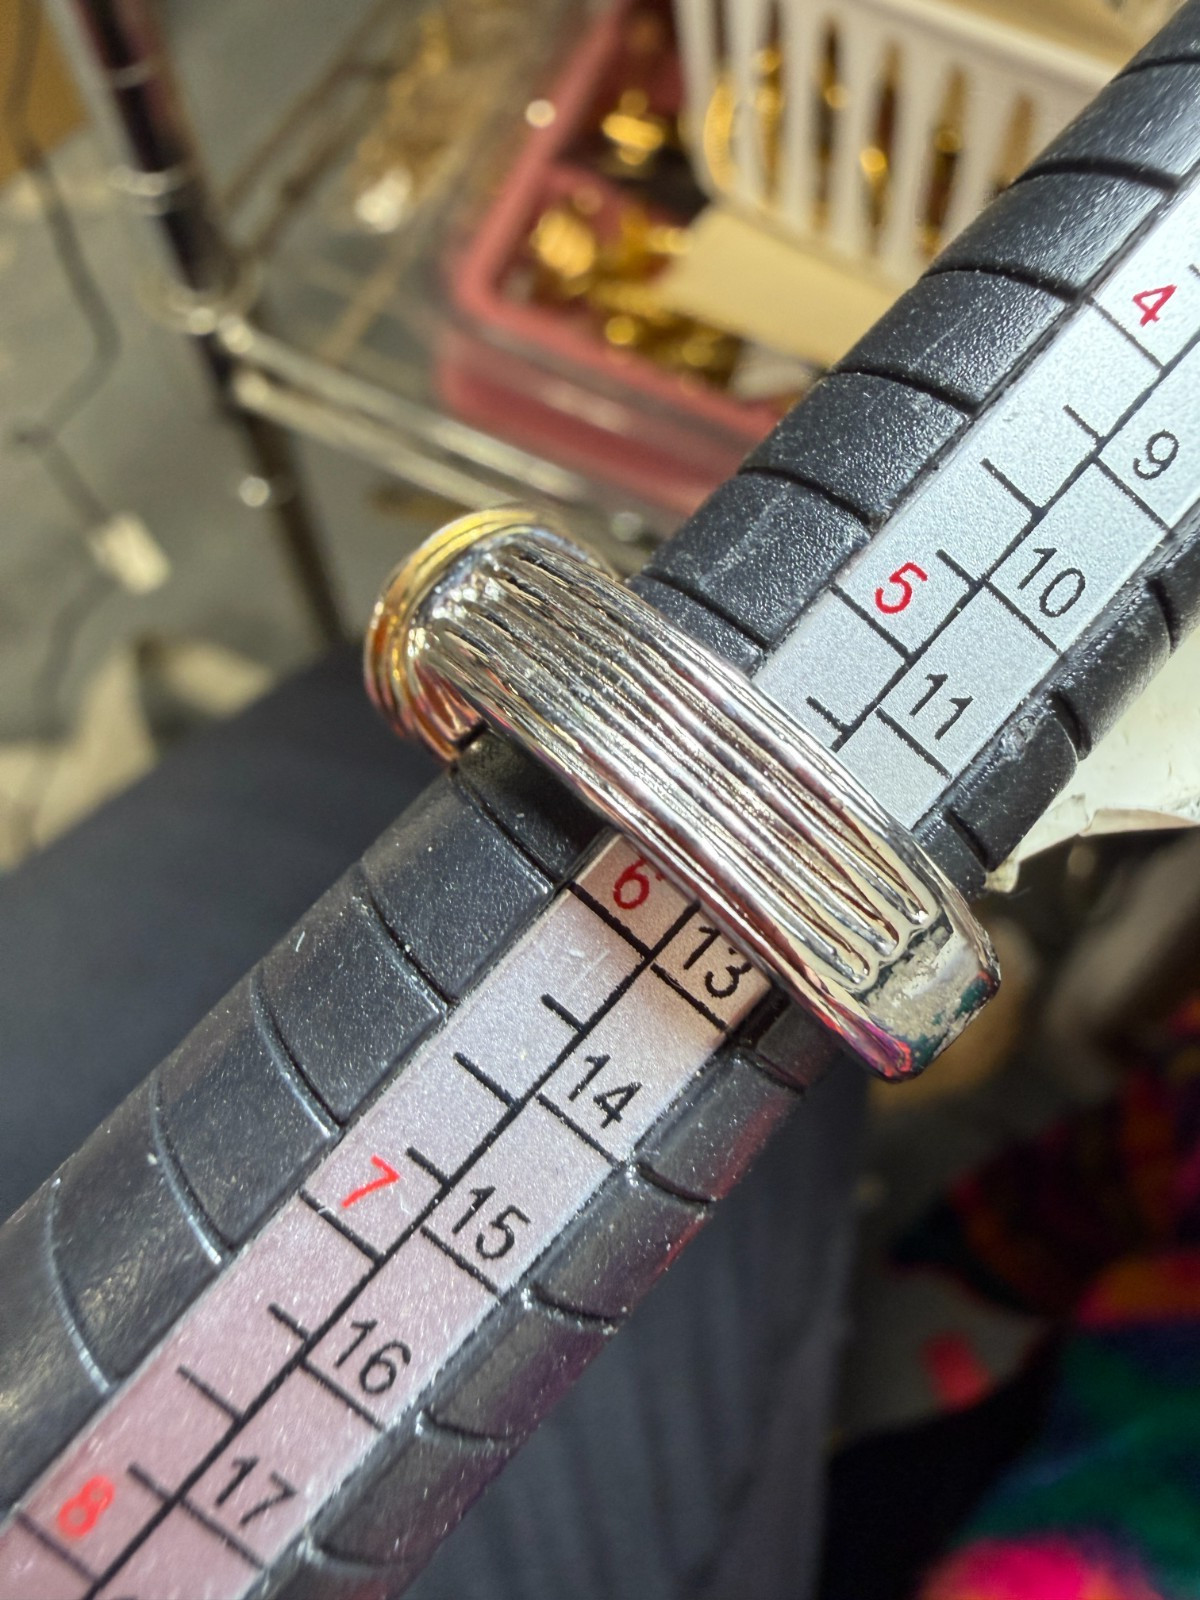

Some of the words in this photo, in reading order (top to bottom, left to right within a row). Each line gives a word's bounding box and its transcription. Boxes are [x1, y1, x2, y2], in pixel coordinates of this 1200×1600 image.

[1132, 283, 1177, 327] 4
[1133, 429, 1179, 480] 9
[875, 561, 928, 614] 5
[1017, 547, 1086, 618] 10
[908, 673, 974, 741] 11
[612, 855, 666, 910] 6
[683, 925, 753, 998] 13
[569, 1054, 643, 1129] 14
[340, 1154, 400, 1210] 7
[452, 1185, 532, 1260] 15
[333, 1319, 412, 1395] 16
[57, 1474, 115, 1541] 8
[215, 1456, 298, 1527] 17
